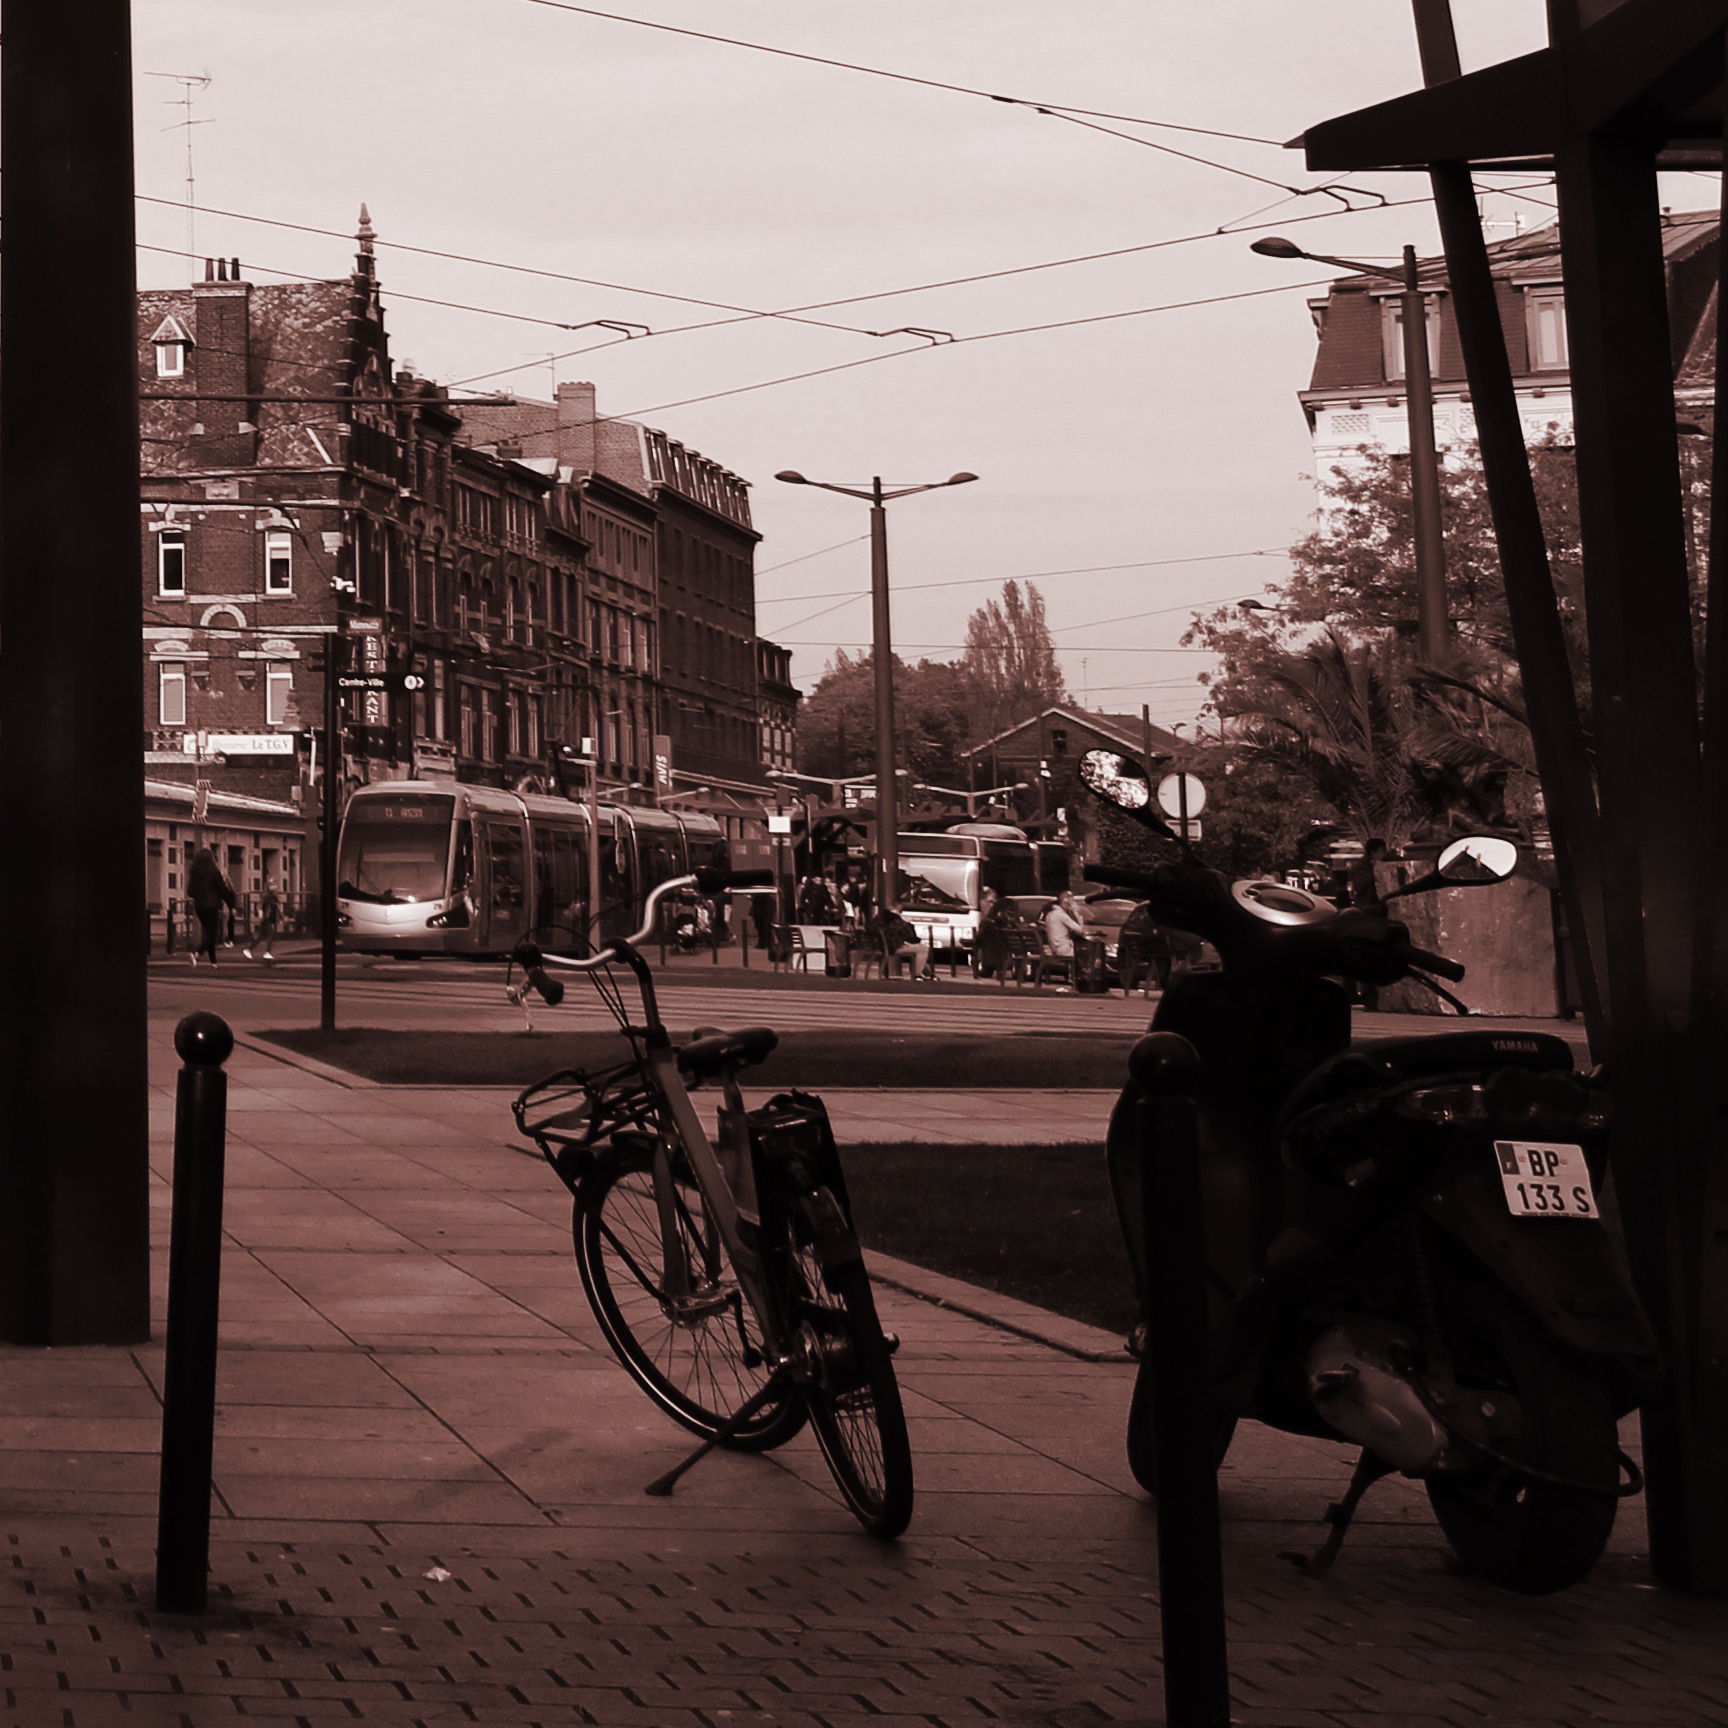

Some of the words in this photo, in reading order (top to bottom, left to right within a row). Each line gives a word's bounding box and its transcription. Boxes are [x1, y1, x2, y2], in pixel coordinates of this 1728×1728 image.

[252, 739, 264, 750] Le
[655, 754, 668, 785] AVIS
[1491, 1039, 1539, 1053] YAMAHA
[1527, 1149, 1559, 1177] BP
[1517, 1183, 1565, 1212] 133
[1572, 1186, 1590, 1213] S
